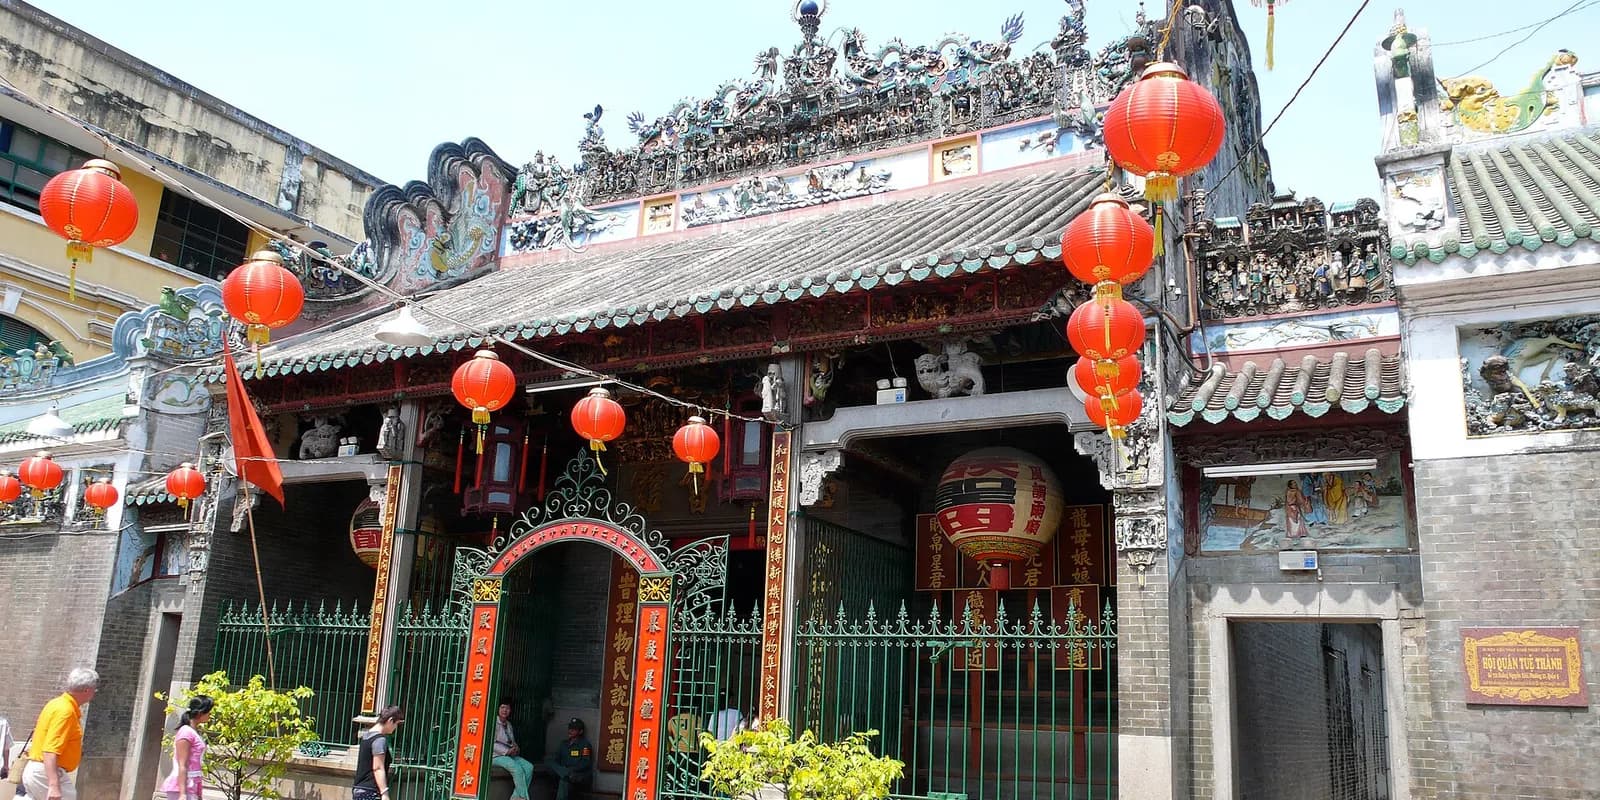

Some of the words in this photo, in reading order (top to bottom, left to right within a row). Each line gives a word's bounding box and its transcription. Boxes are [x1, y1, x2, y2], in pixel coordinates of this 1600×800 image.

[1069, 507, 1094, 584] 龍母娘娘
[1482, 653, 1496, 672] HỘI
[1497, 653, 1518, 672] QUÁN
[1535, 653, 1562, 671] THÀNH
